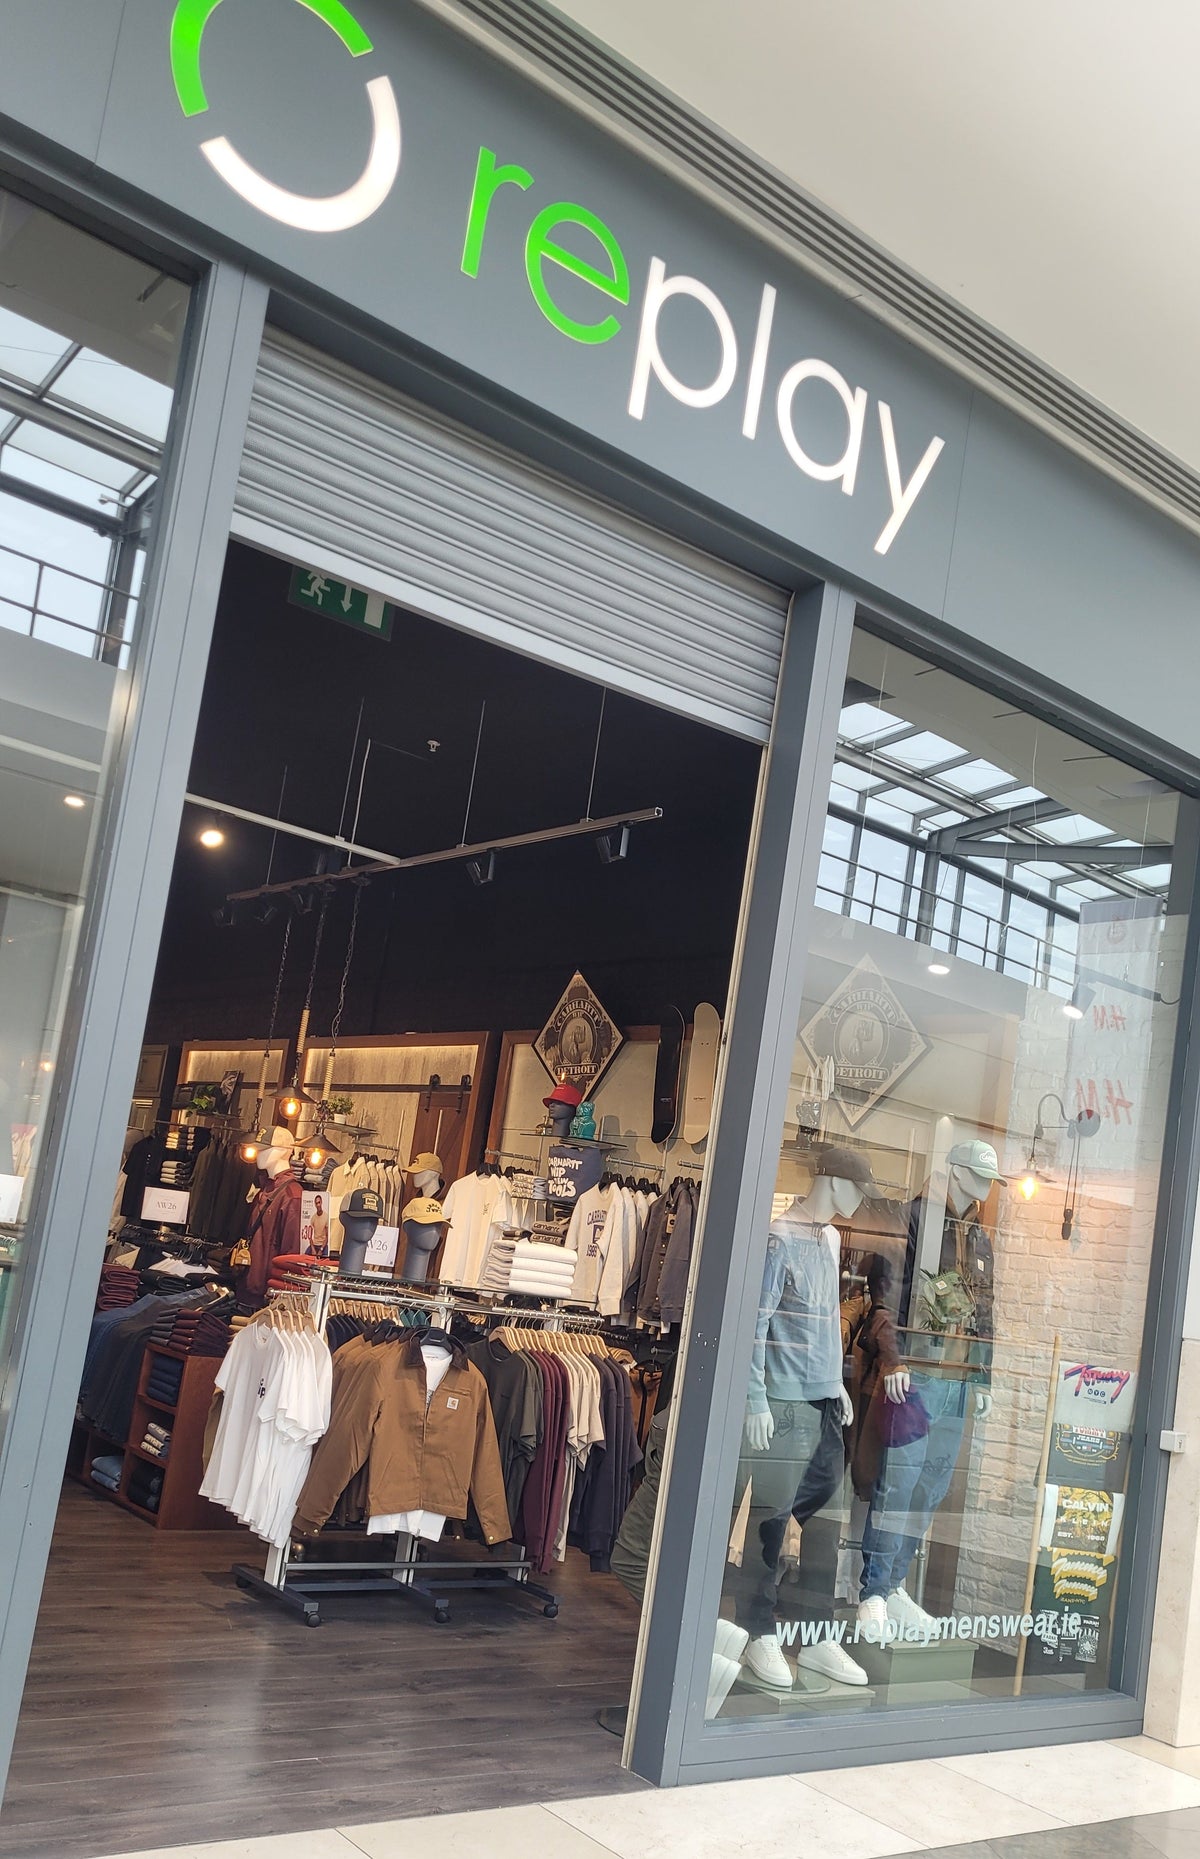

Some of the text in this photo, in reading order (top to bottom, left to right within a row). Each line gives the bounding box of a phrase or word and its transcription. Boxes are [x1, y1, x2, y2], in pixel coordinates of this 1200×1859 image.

[459, 145, 946, 556] replay
[556, 1064, 597, 1075] DETROIT
[835, 1066, 886, 1080] DETROIT
[550, 1166, 566, 1178] WIP
[547, 1179, 577, 1198] TOOLS
[1064, 1363, 1131, 1405] Tommy
[1087, 1388, 1106, 1398] NYC
[1062, 1498, 1109, 1513] CALVIN
[775, 1605, 1082, 1650] www.replaymenswear.ie
